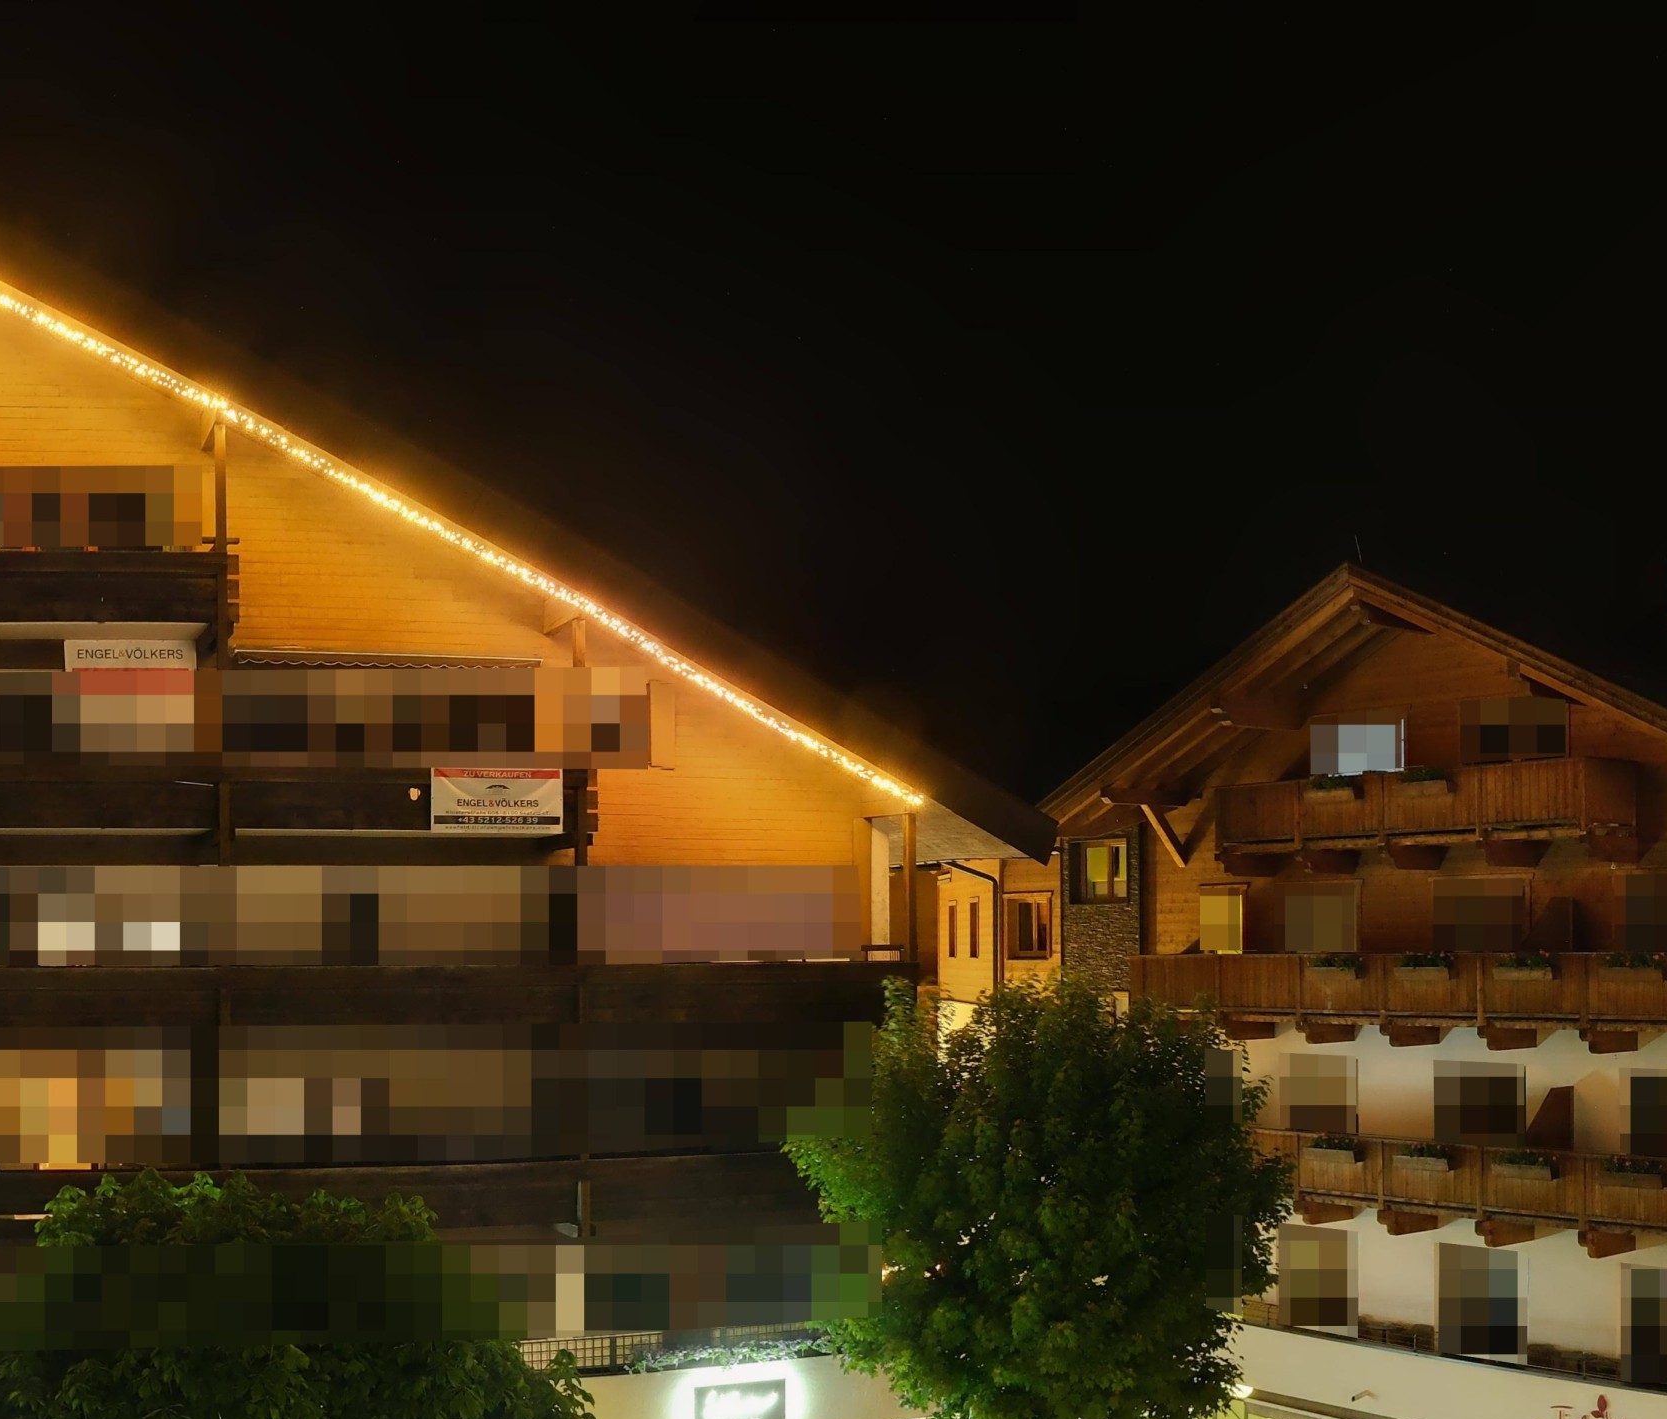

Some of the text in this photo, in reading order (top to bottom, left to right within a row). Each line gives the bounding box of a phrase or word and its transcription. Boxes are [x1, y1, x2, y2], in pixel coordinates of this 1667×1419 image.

[77, 647, 184, 660] ENGEL&VÖLKERS
[463, 770, 532, 779] ZU VERKAUFEN
[458, 816, 475, 824] +43
[526, 816, 539, 824] 39
